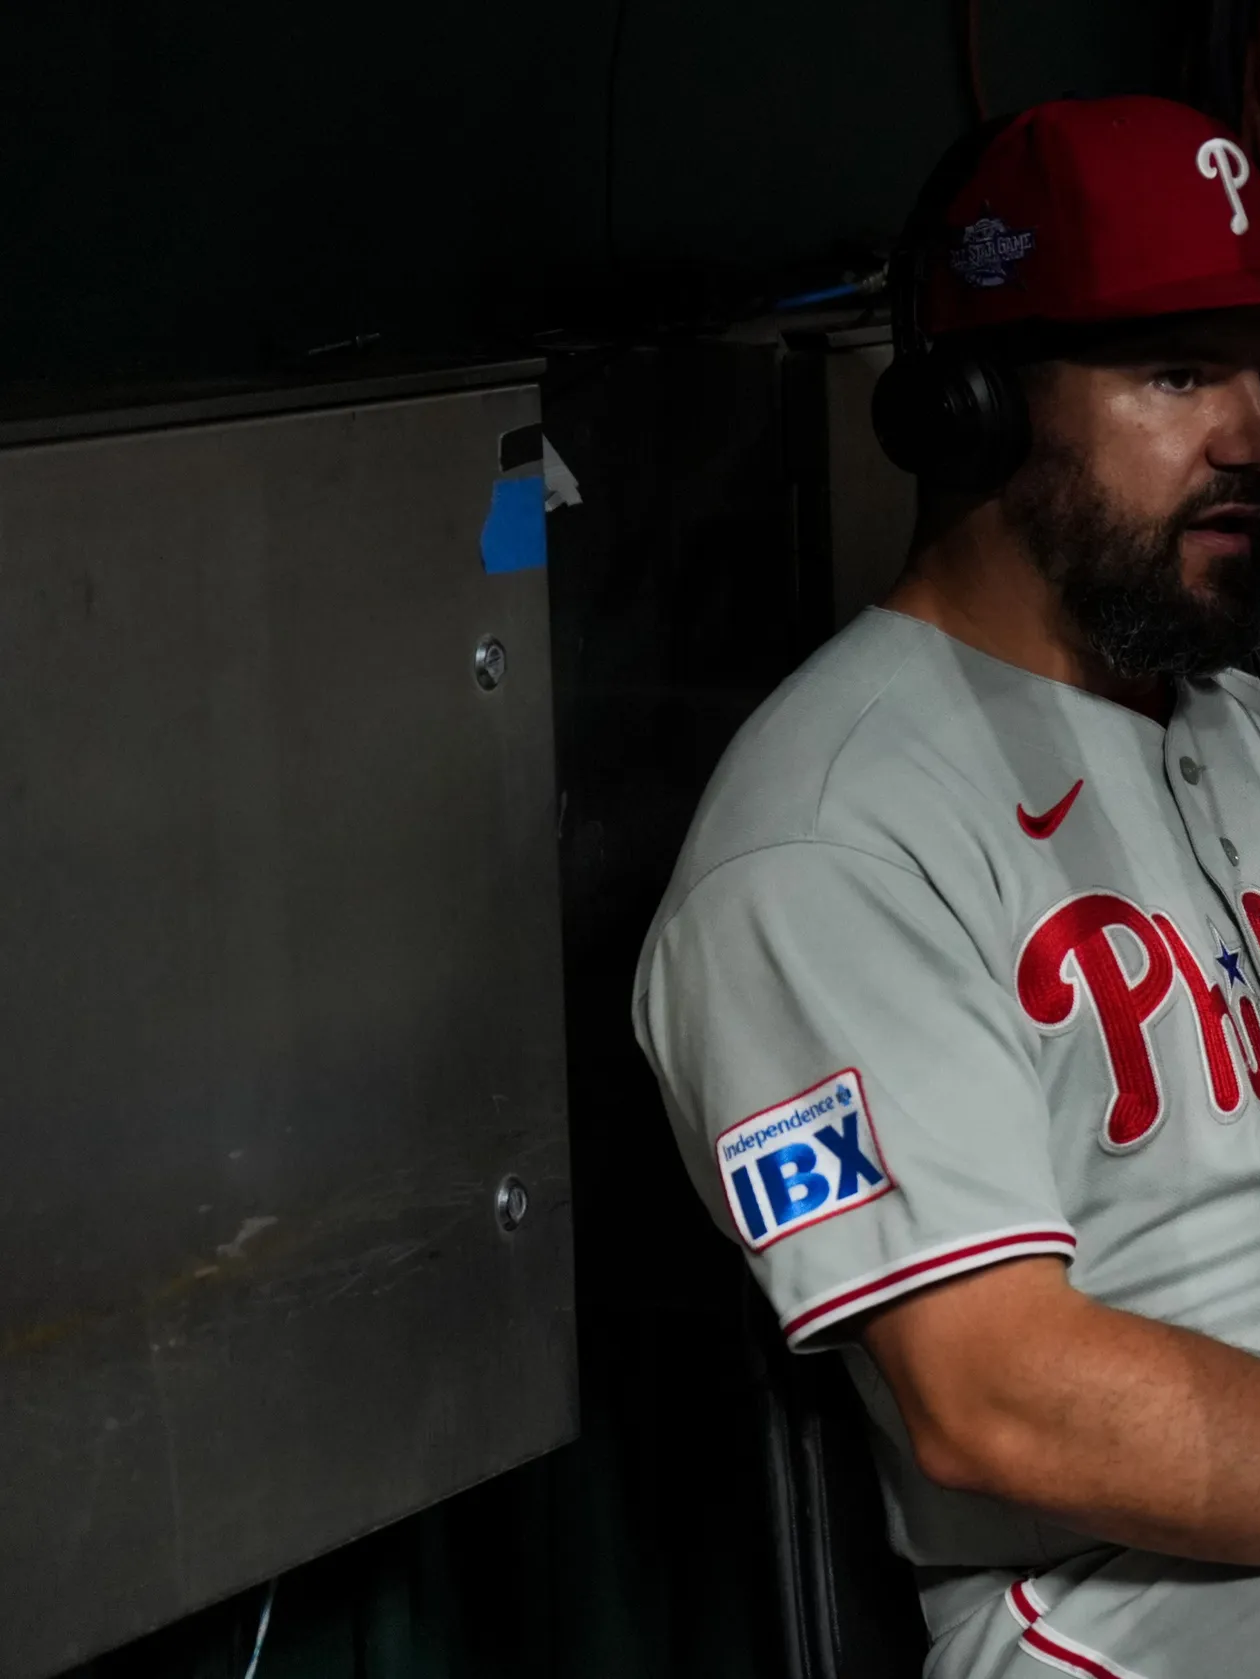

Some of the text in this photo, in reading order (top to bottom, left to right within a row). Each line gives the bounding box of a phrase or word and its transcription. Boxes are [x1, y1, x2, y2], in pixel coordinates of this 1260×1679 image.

[1196, 138, 1250, 235] P
[998, 232, 1032, 255] GAME
[731, 1111, 884, 1240] IBX
